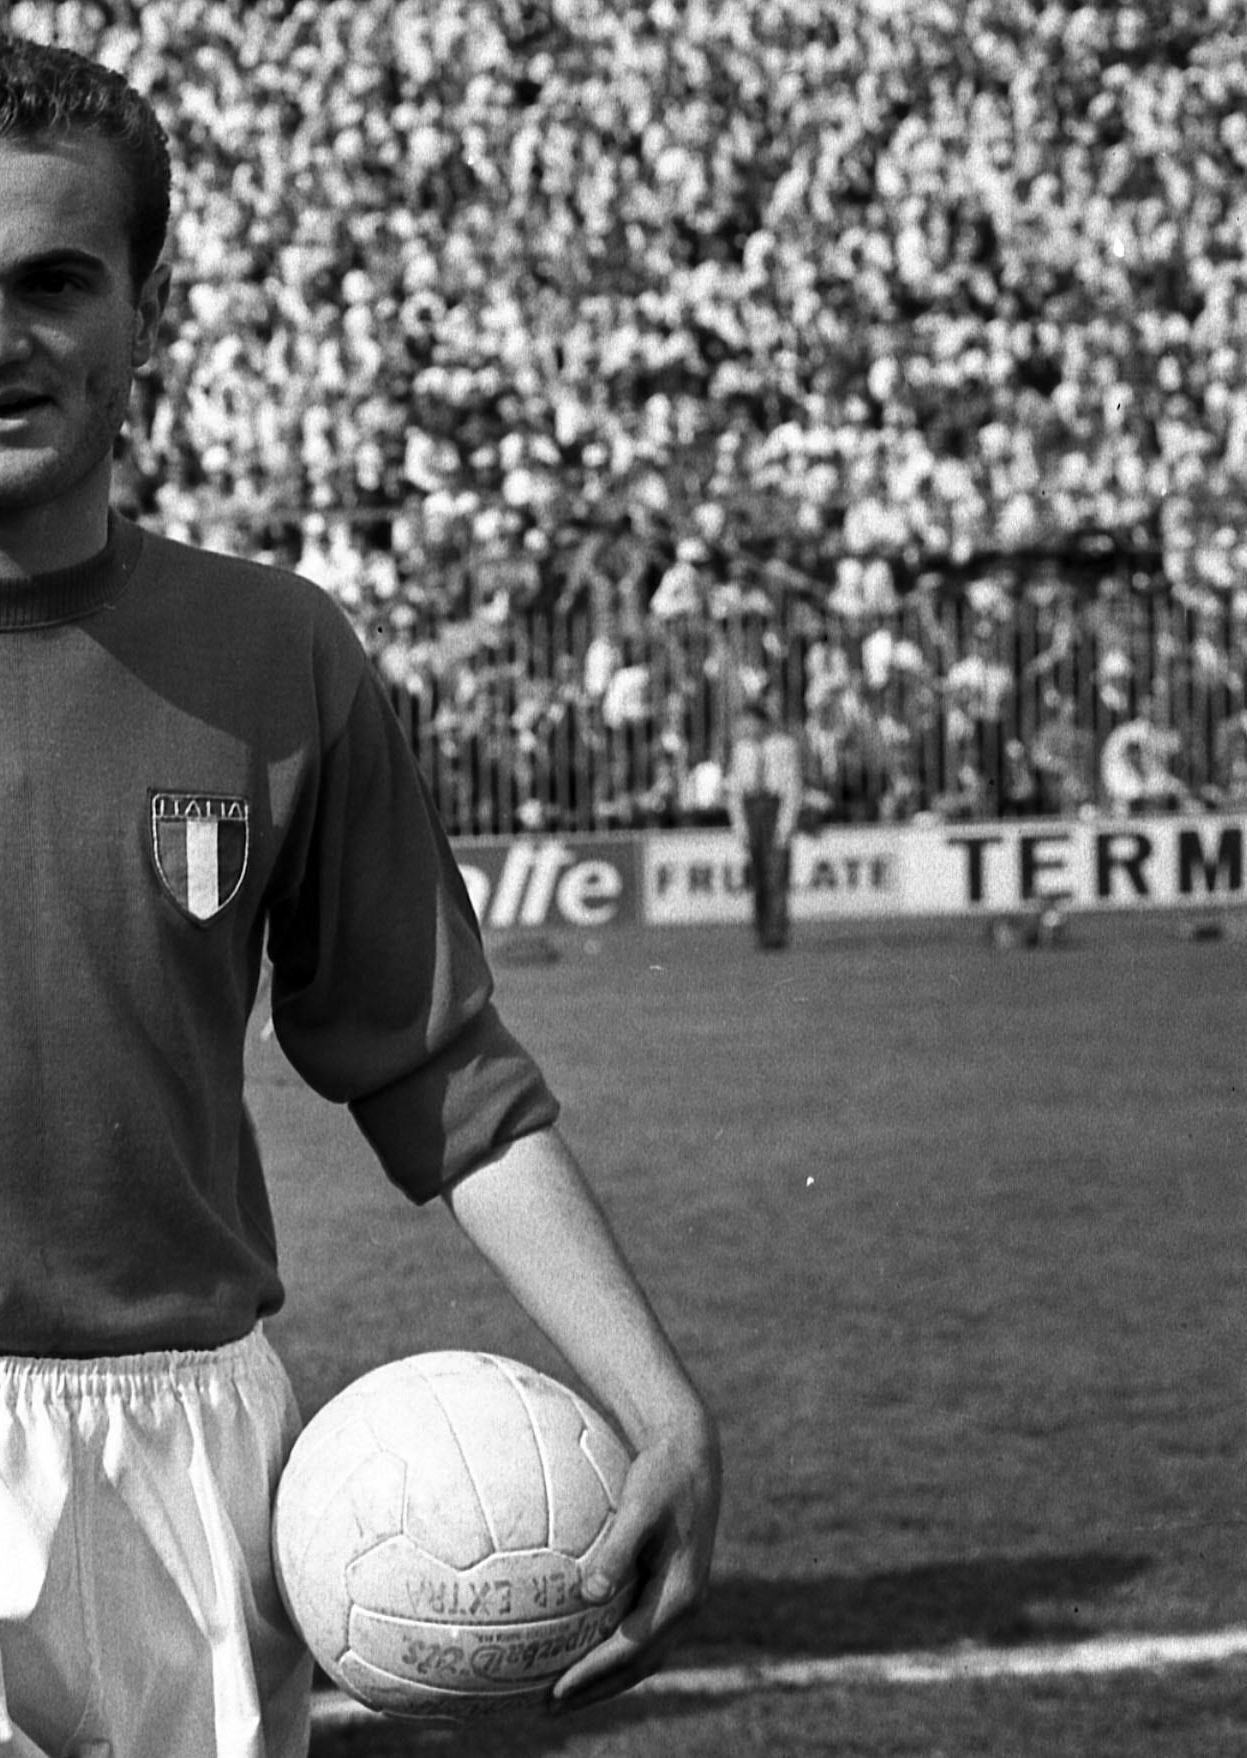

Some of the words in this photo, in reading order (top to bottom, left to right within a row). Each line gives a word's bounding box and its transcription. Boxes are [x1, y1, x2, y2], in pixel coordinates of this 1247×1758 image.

[159, 797, 244, 820] ITALIA
[947, 828, 1244, 902] TERM
[405, 1579, 512, 1616] EXTRA
